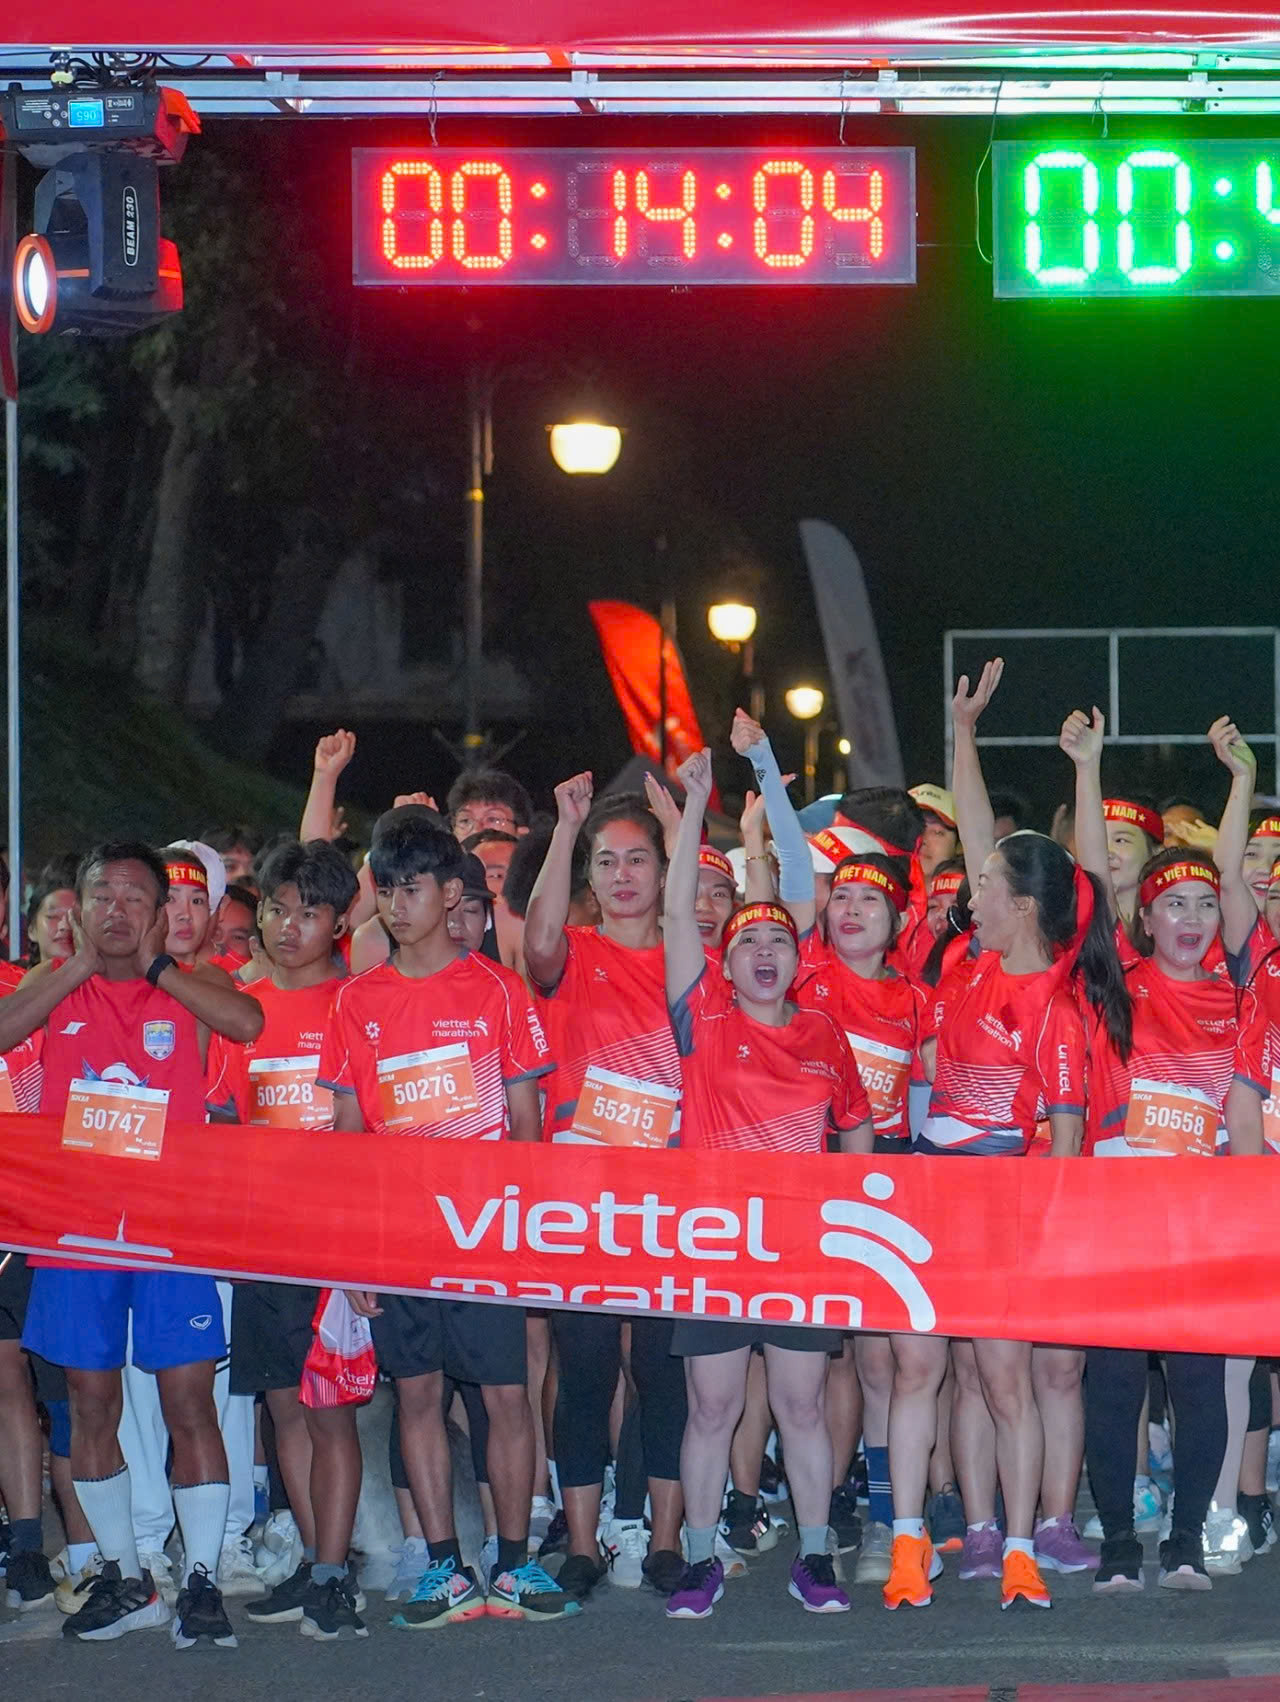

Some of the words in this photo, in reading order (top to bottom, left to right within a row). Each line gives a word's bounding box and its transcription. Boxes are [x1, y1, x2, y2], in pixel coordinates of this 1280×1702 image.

[125, 196, 135, 219] 230
[379, 160, 883, 270] 00:14:04
[126, 220, 135, 256] BEAM
[1111, 804, 1138, 821] NAM
[862, 867, 887, 888] NAM
[1163, 866, 1187, 882] VIỆT
[1190, 865, 1214, 881] NAM
[738, 906, 763, 923] NAM
[431, 1019, 471, 1029] viettel
[431, 1029, 481, 1038] marathon
[527, 1007, 550, 1058] unitel
[1057, 1044, 1073, 1096] unitel
[257, 1082, 314, 1107] 50228
[393, 1072, 456, 1105] 50276
[82, 1106, 147, 1136] 50747
[592, 1095, 655, 1131] 55215
[1144, 1104, 1205, 1137] 50558
[434, 1184, 781, 1263] viettel
